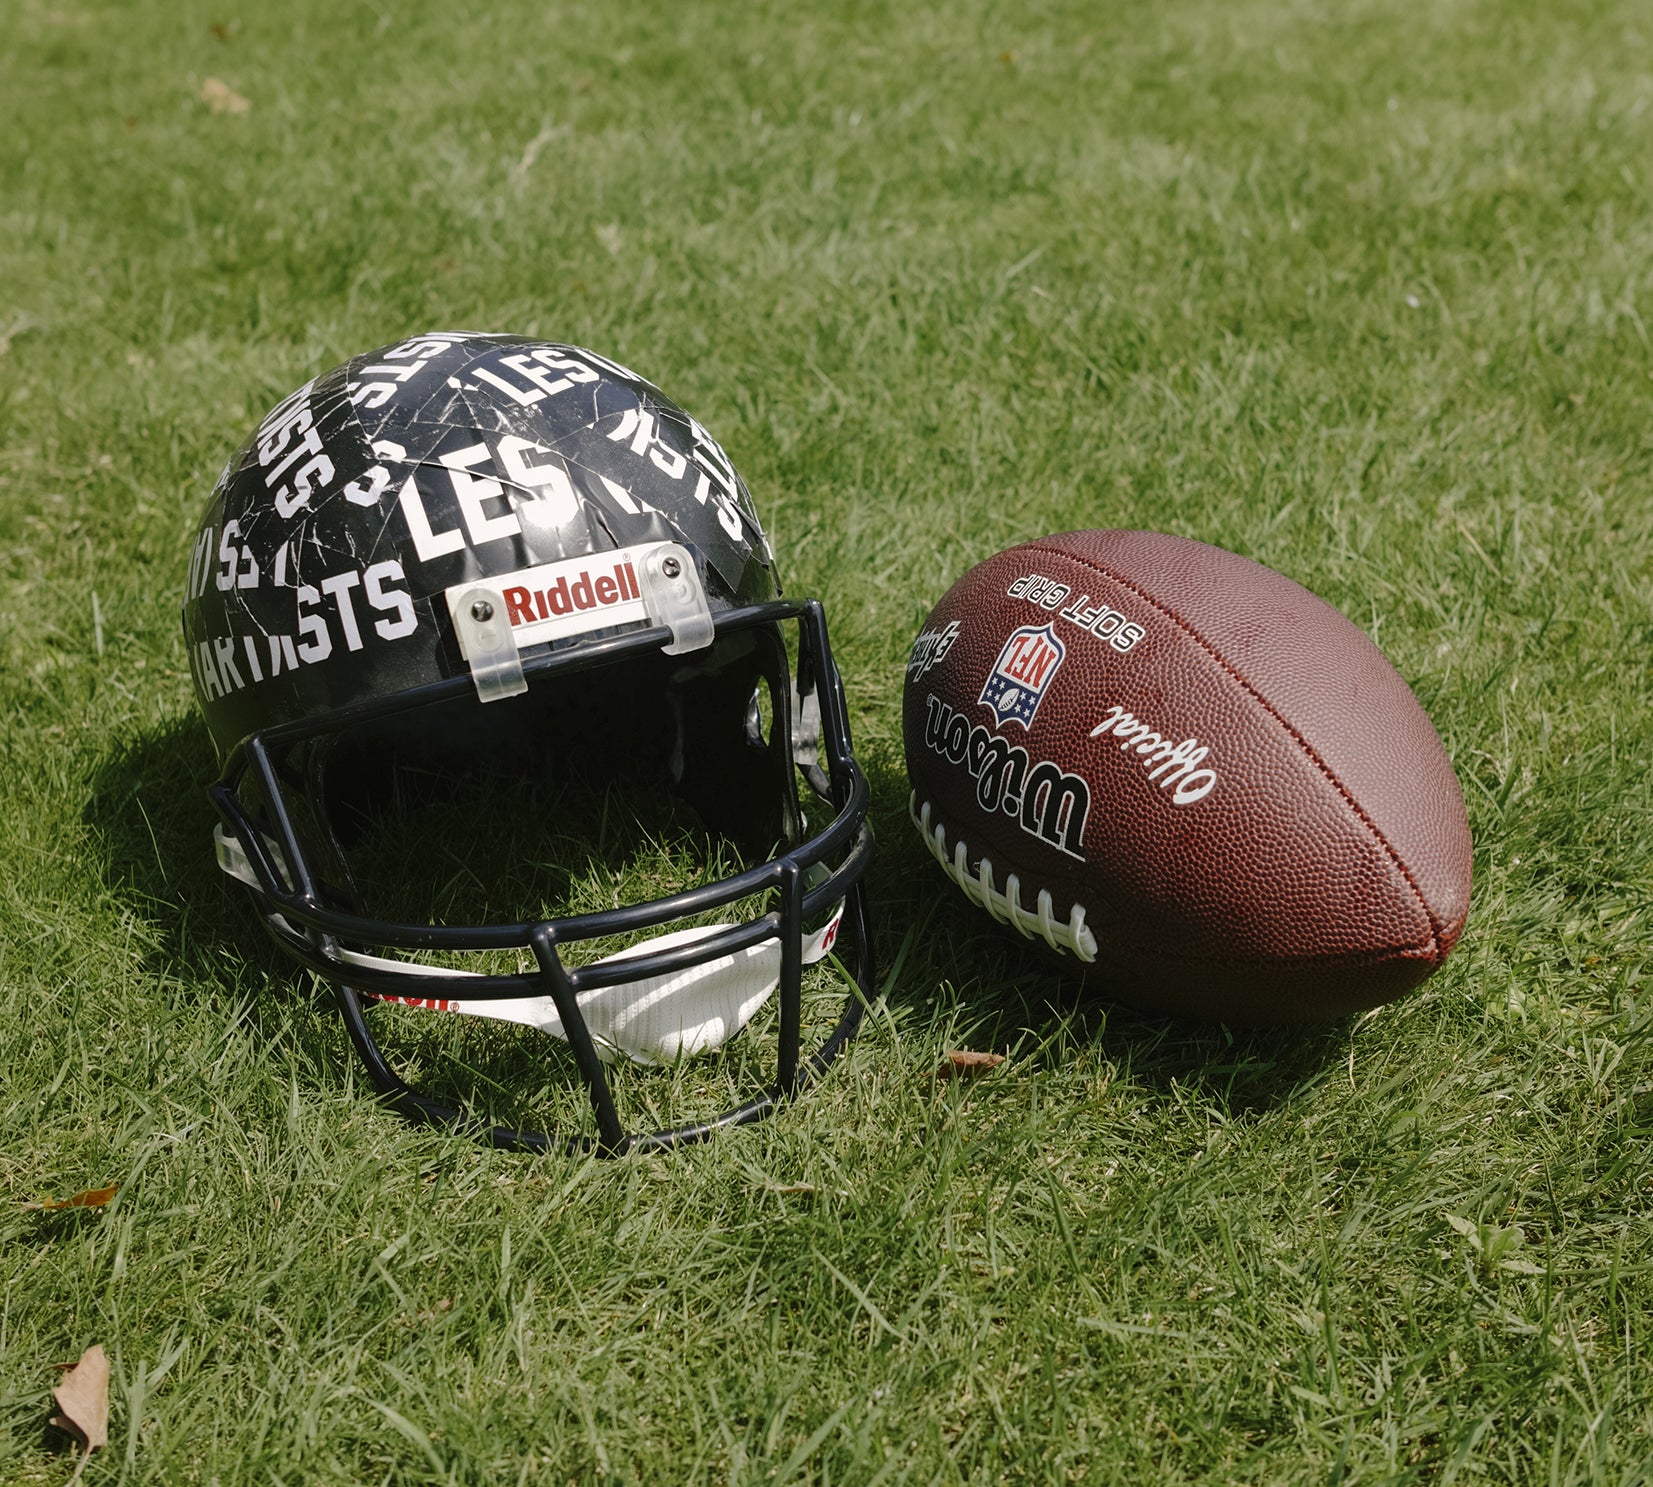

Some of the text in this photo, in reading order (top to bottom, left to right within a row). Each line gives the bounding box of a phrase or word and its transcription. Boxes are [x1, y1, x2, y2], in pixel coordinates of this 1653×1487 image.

[470, 350, 600, 407] LES
[399, 434, 580, 563] LES
[502, 562, 641, 627] Riddell
[1007, 573, 1147, 654] SOFT GRIP
[1003, 636, 1057, 689] NFL
[925, 695, 1091, 862] Wilson
[1090, 706, 1217, 805] Official
